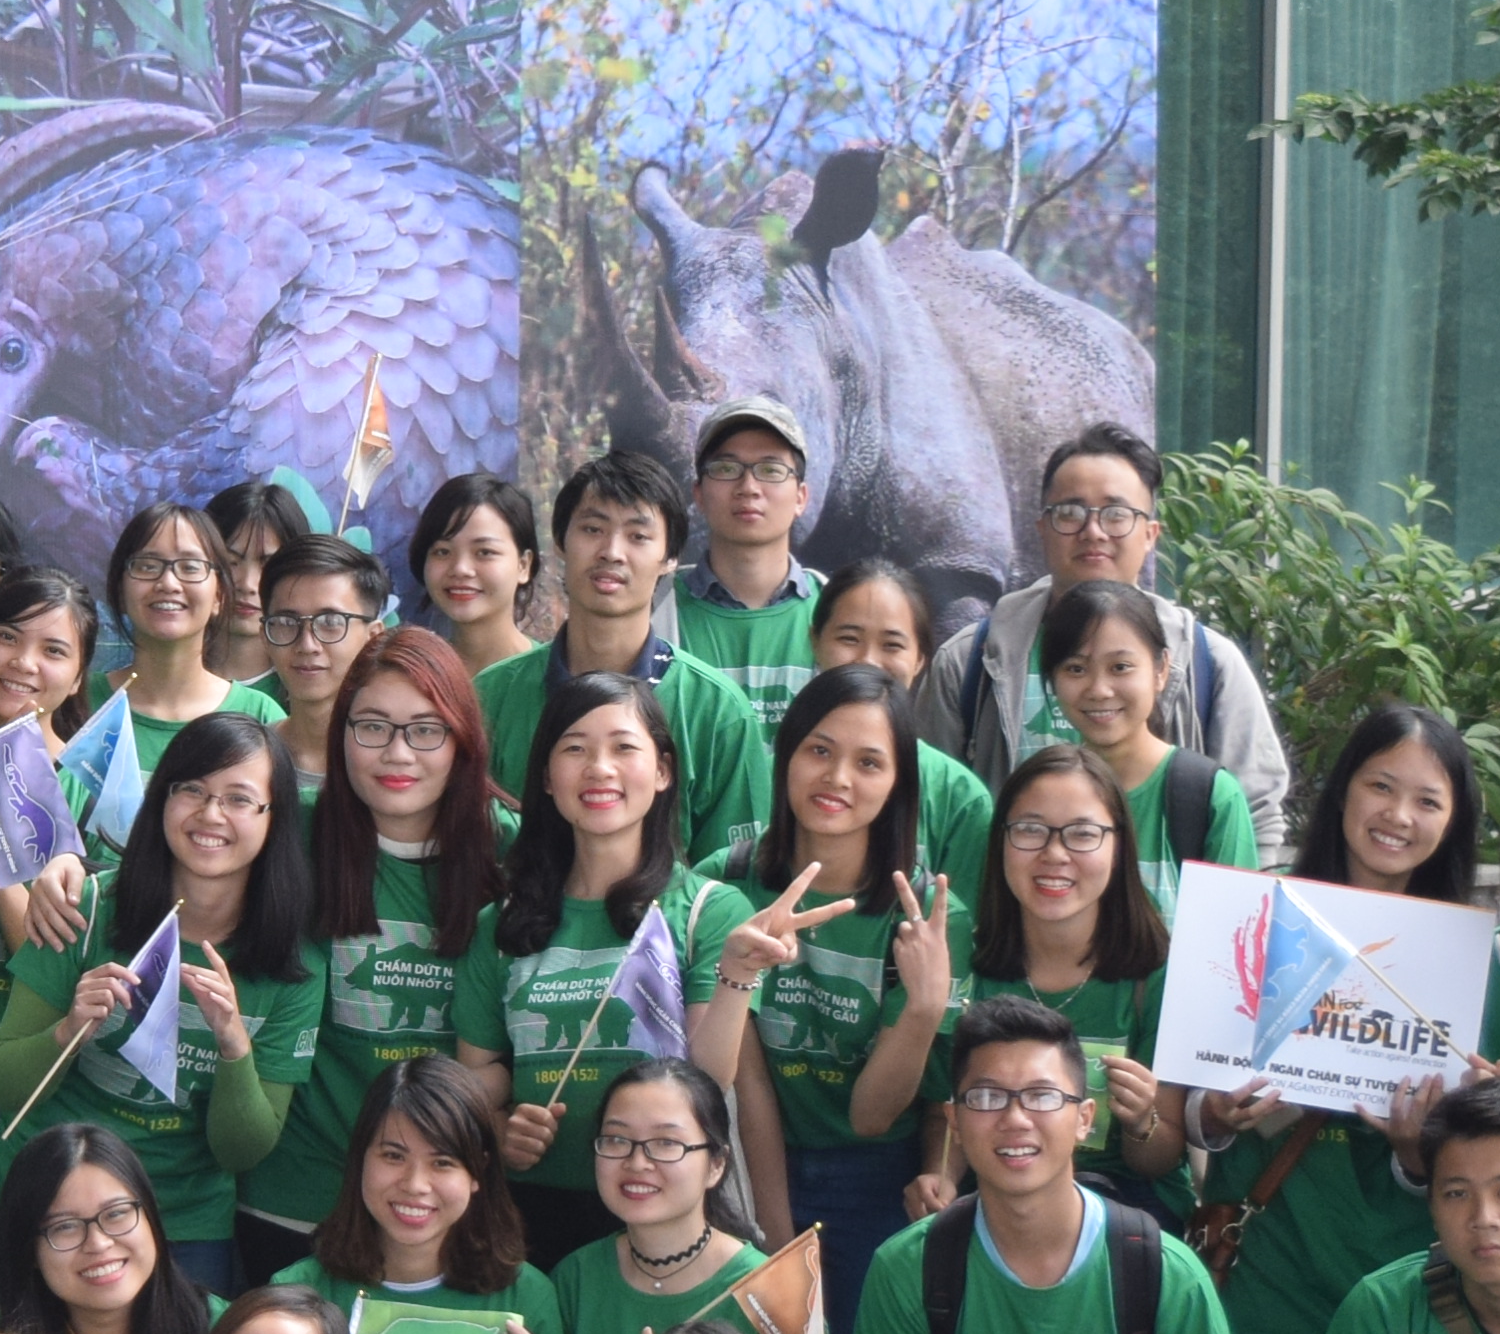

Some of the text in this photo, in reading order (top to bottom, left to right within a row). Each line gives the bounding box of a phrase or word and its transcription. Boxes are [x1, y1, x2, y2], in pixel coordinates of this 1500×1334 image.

[571, 1068, 599, 1082] 1522
[1287, 1080, 1387, 1106] AGAINST EXTINCTION
